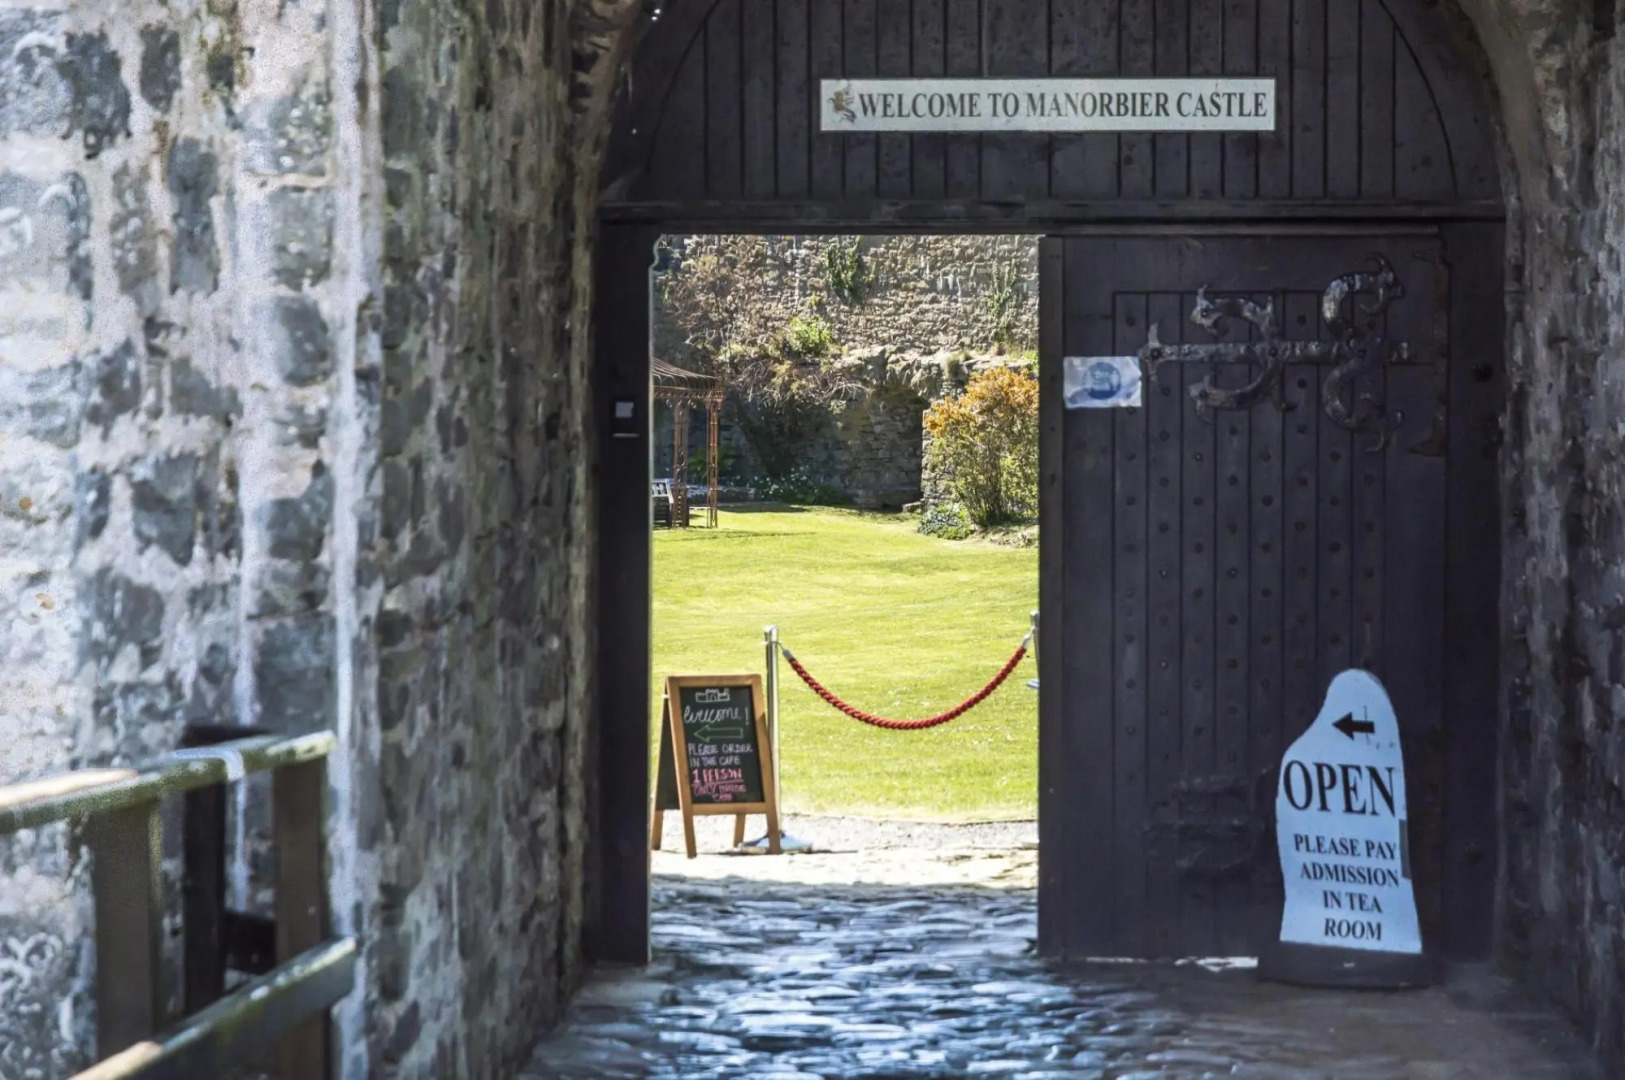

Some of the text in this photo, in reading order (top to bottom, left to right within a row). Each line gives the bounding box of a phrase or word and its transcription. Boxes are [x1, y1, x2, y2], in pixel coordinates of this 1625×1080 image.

[858, 91, 1268, 119] WELCOME TO MANORBIER CASTLE
[690, 757, 699, 767] IN
[702, 756, 717, 766] THE
[1282, 760, 1396, 817] OPEN
[1293, 832, 1397, 860] PLEASE PAY
[1299, 861, 1400, 888] ADMISSION
[1322, 889, 1383, 914] IN TEA
[1324, 917, 1383, 941] ROOM
